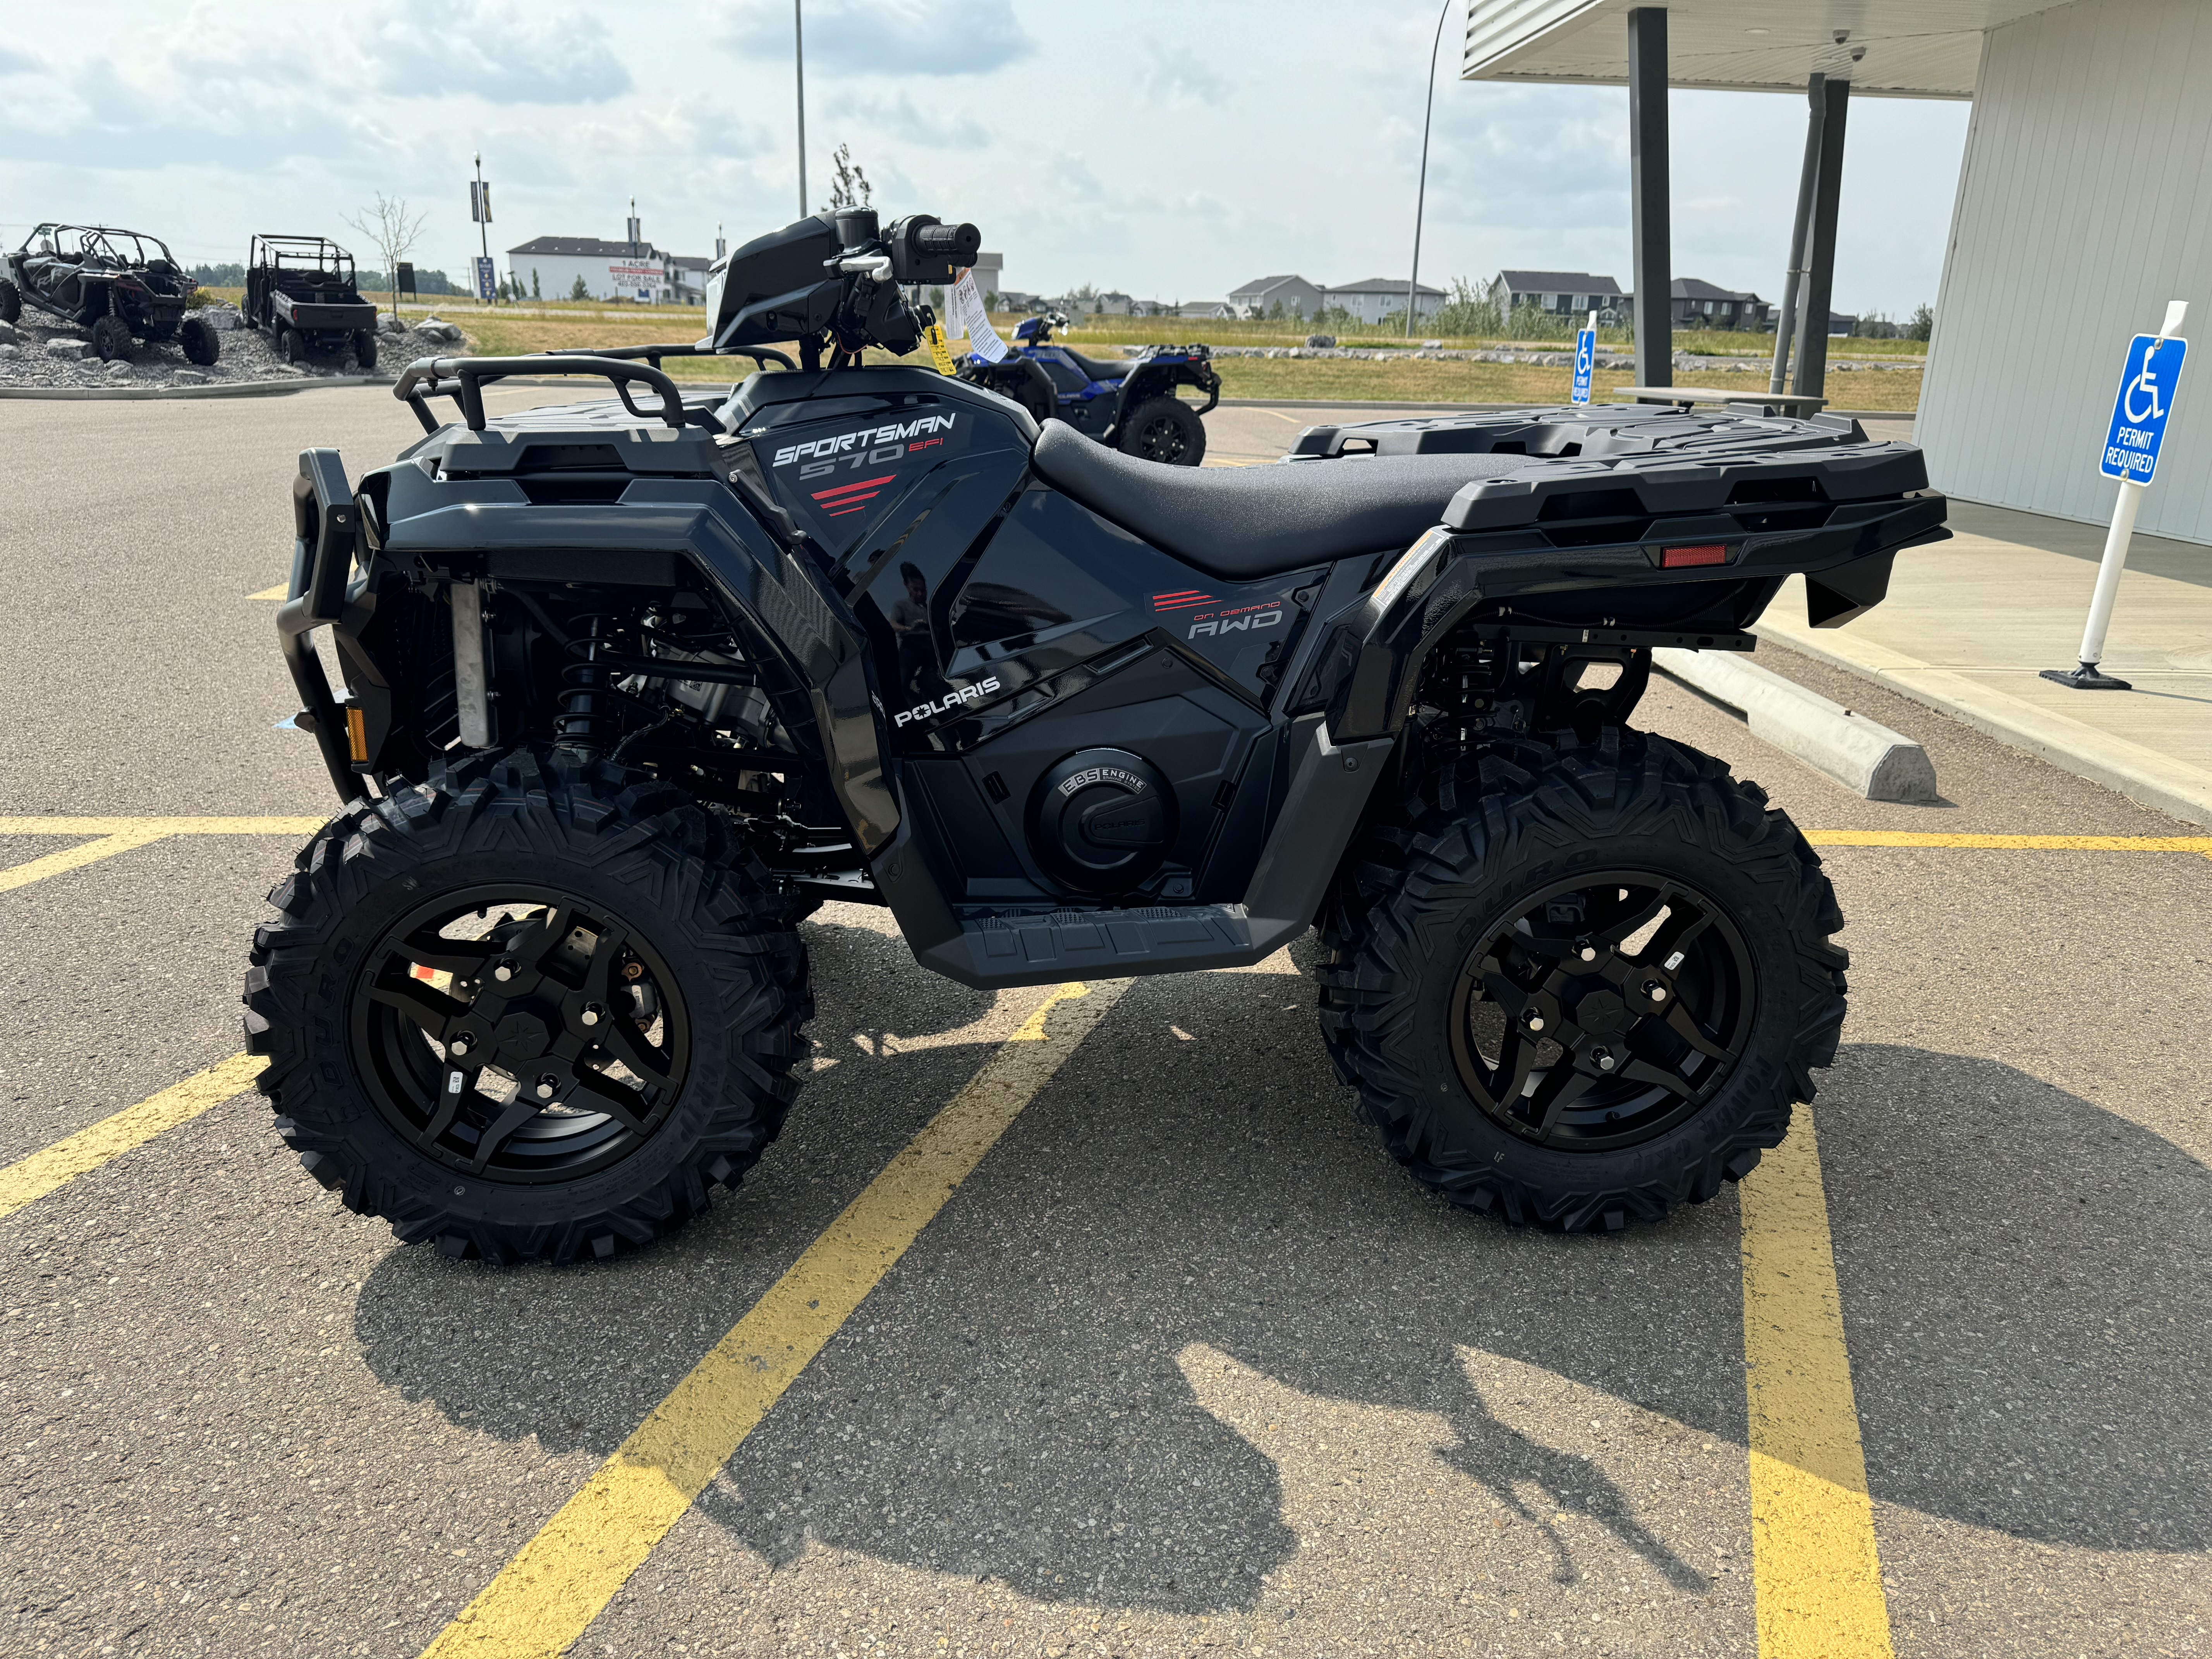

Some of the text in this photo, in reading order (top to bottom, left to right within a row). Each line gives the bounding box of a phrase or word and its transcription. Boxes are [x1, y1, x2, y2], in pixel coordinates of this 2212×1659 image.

[772, 412, 956, 467] SPORTSMAN
[2116, 427, 2154, 450] PERMIT
[799, 438, 943, 481] 570 EFI
[2106, 447, 2154, 473] REQUIRED
[1393, 546, 1418, 574] WARNING
[1220, 601, 1281, 617] DEMAND
[1188, 610, 1283, 639] AWD
[894, 676, 1000, 728] POLARIS
[1063, 769, 1144, 793] EBS ENGINE
[1124, 780, 1140, 792] SYSTEM
[1094, 819, 1145, 830] POLARIS
[1453, 848, 1598, 950] DURO
[314, 937, 355, 1086] DURO
